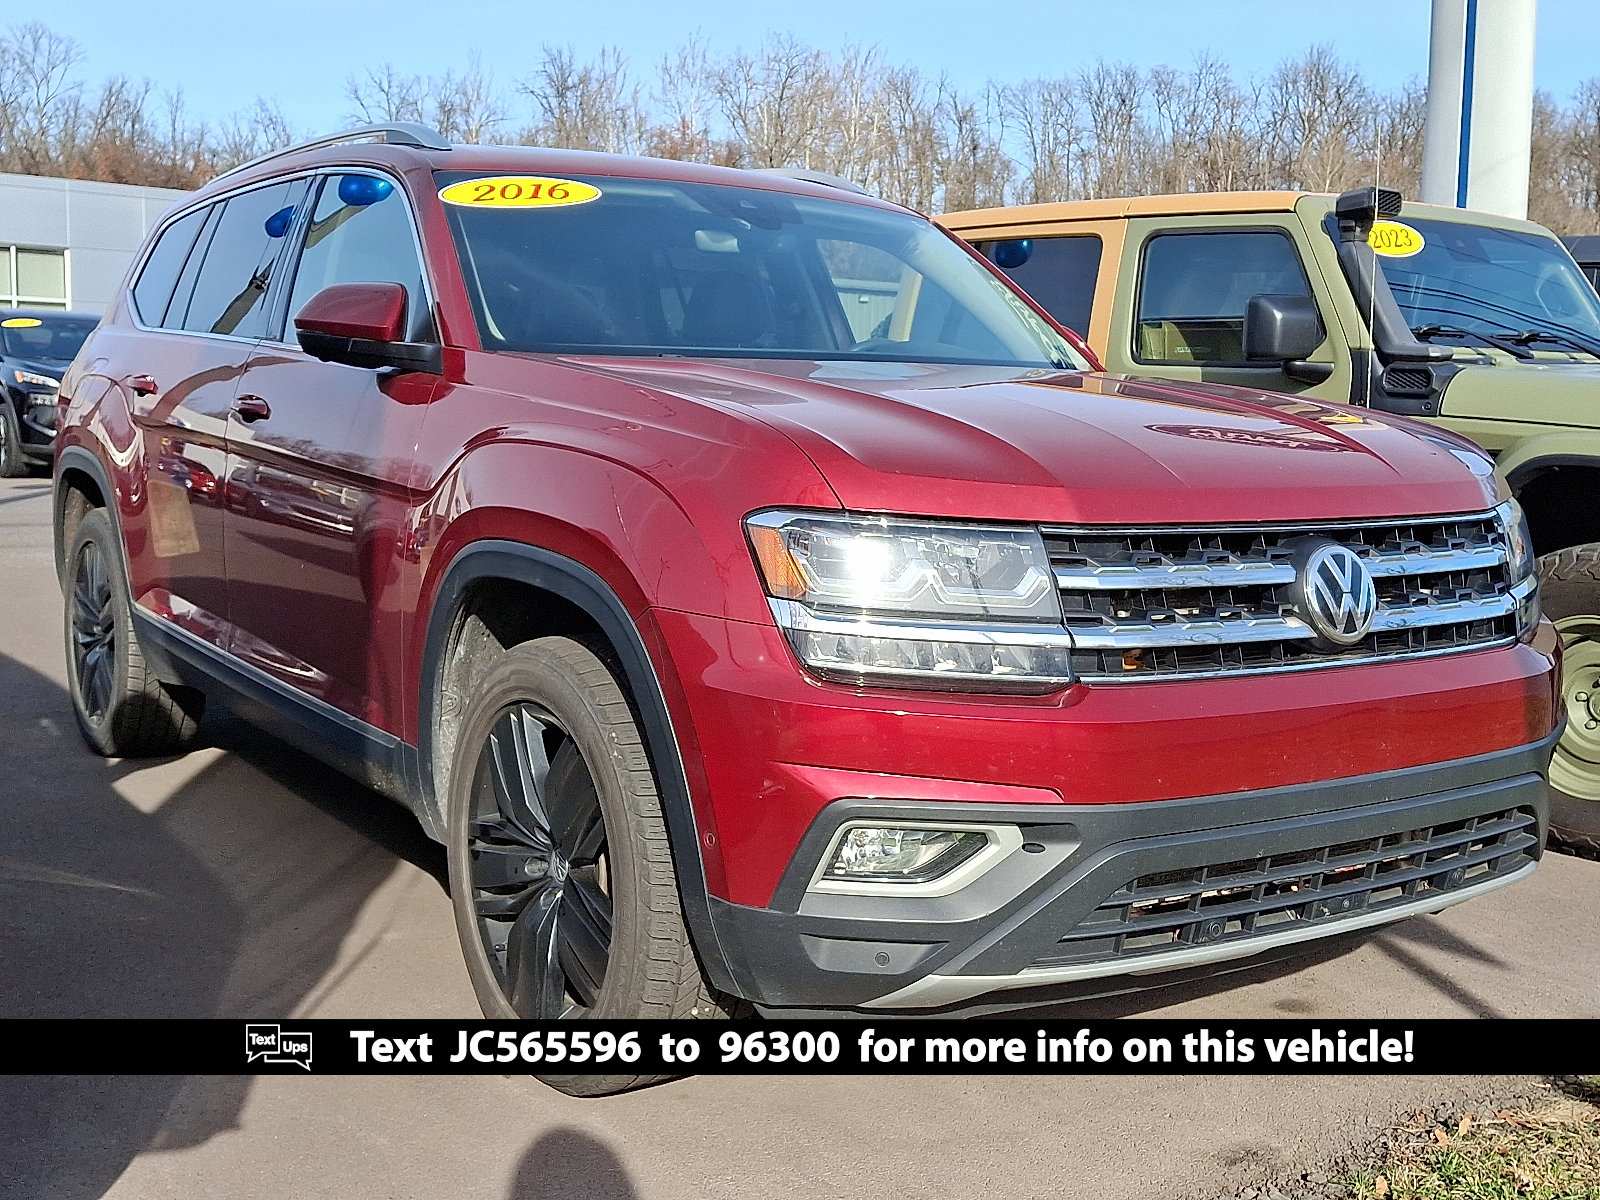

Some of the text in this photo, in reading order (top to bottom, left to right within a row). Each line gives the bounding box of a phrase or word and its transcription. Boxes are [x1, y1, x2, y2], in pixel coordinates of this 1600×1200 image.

[473, 182, 570, 202] 2016
[1369, 228, 1413, 249] 2023
[1306, 545, 1375, 641] VW
